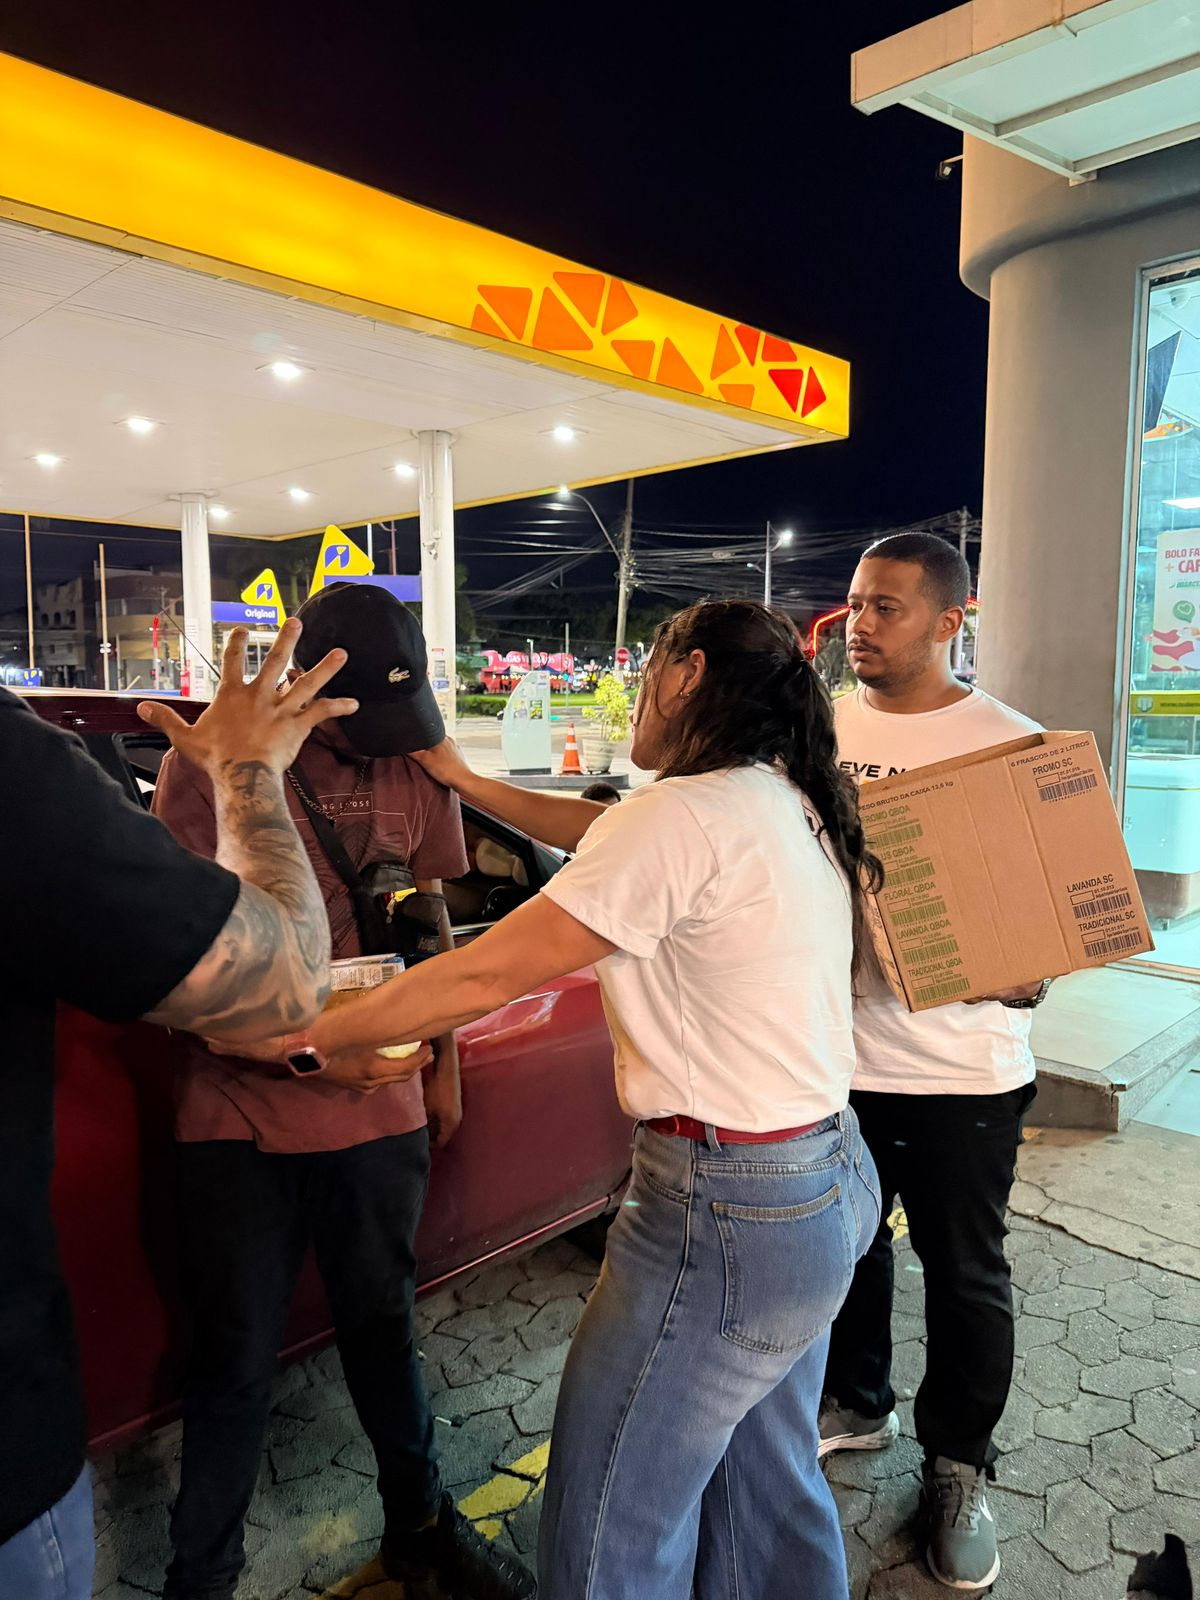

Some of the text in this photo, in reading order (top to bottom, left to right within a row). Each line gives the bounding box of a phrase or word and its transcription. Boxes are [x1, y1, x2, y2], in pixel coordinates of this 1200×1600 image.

[1165, 548, 1200, 559] BOLO FA
[244, 608, 275, 619] Original
[1016, 752, 1049, 766] FRASCOS
[1049, 749, 1060, 757] DE
[1065, 740, 1090, 752] LITROS
[1032, 761, 1061, 776] PROMO
[1062, 757, 1073, 767] SC
[876, 796, 899, 807] BRUTO
[899, 792, 910, 800] DA
[910, 786, 931, 797] CAIXA
[888, 804, 911, 817] QBOA
[892, 845, 915, 857] QBOA
[884, 887, 914, 900] FLORAL
[914, 881, 936, 893] QBOA
[1067, 876, 1103, 893] LAVANDA
[1102, 873, 1114, 884] SC
[895, 924, 929, 939] LAVANDA
[929, 919, 952, 931] QBOA
[1078, 914, 1125, 932] TRADICIONAL
[1125, 910, 1136, 920] SC
[908, 962, 946, 977] TRADICIONAL
[946, 957, 964, 969] QBOA
